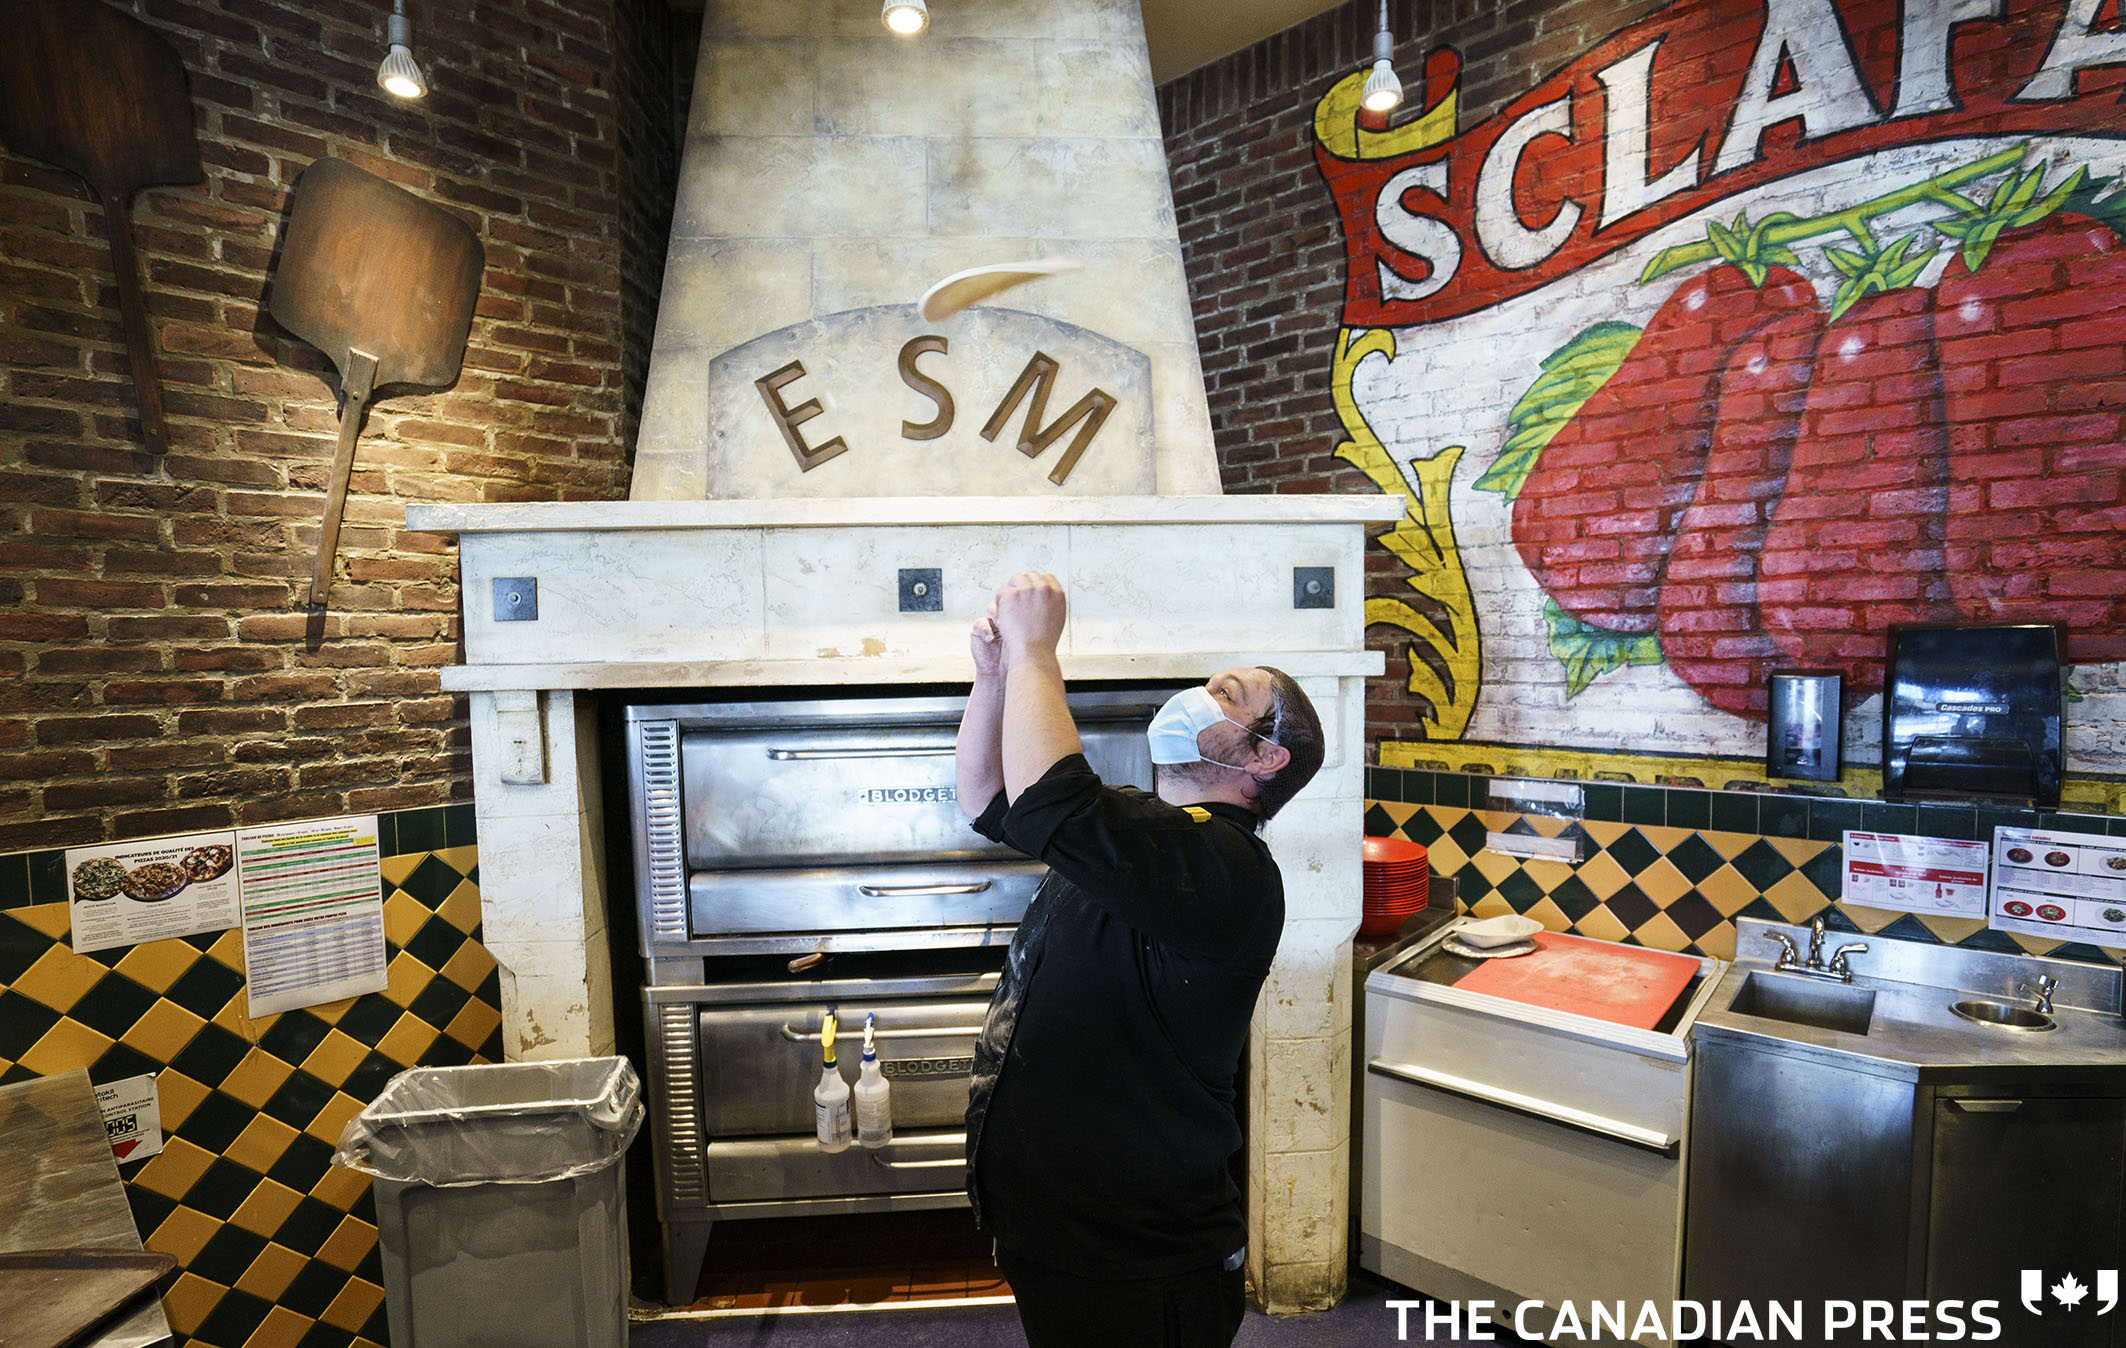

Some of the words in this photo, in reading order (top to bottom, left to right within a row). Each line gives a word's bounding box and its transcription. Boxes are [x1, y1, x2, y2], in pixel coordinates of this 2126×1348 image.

[754, 334, 1118, 487] ESM
[1941, 704, 1984, 712] Cascades
[871, 788, 957, 802] BLODGET
[885, 1059, 970, 1074] BLODGET
[128, 1103, 151, 1111] STATION
